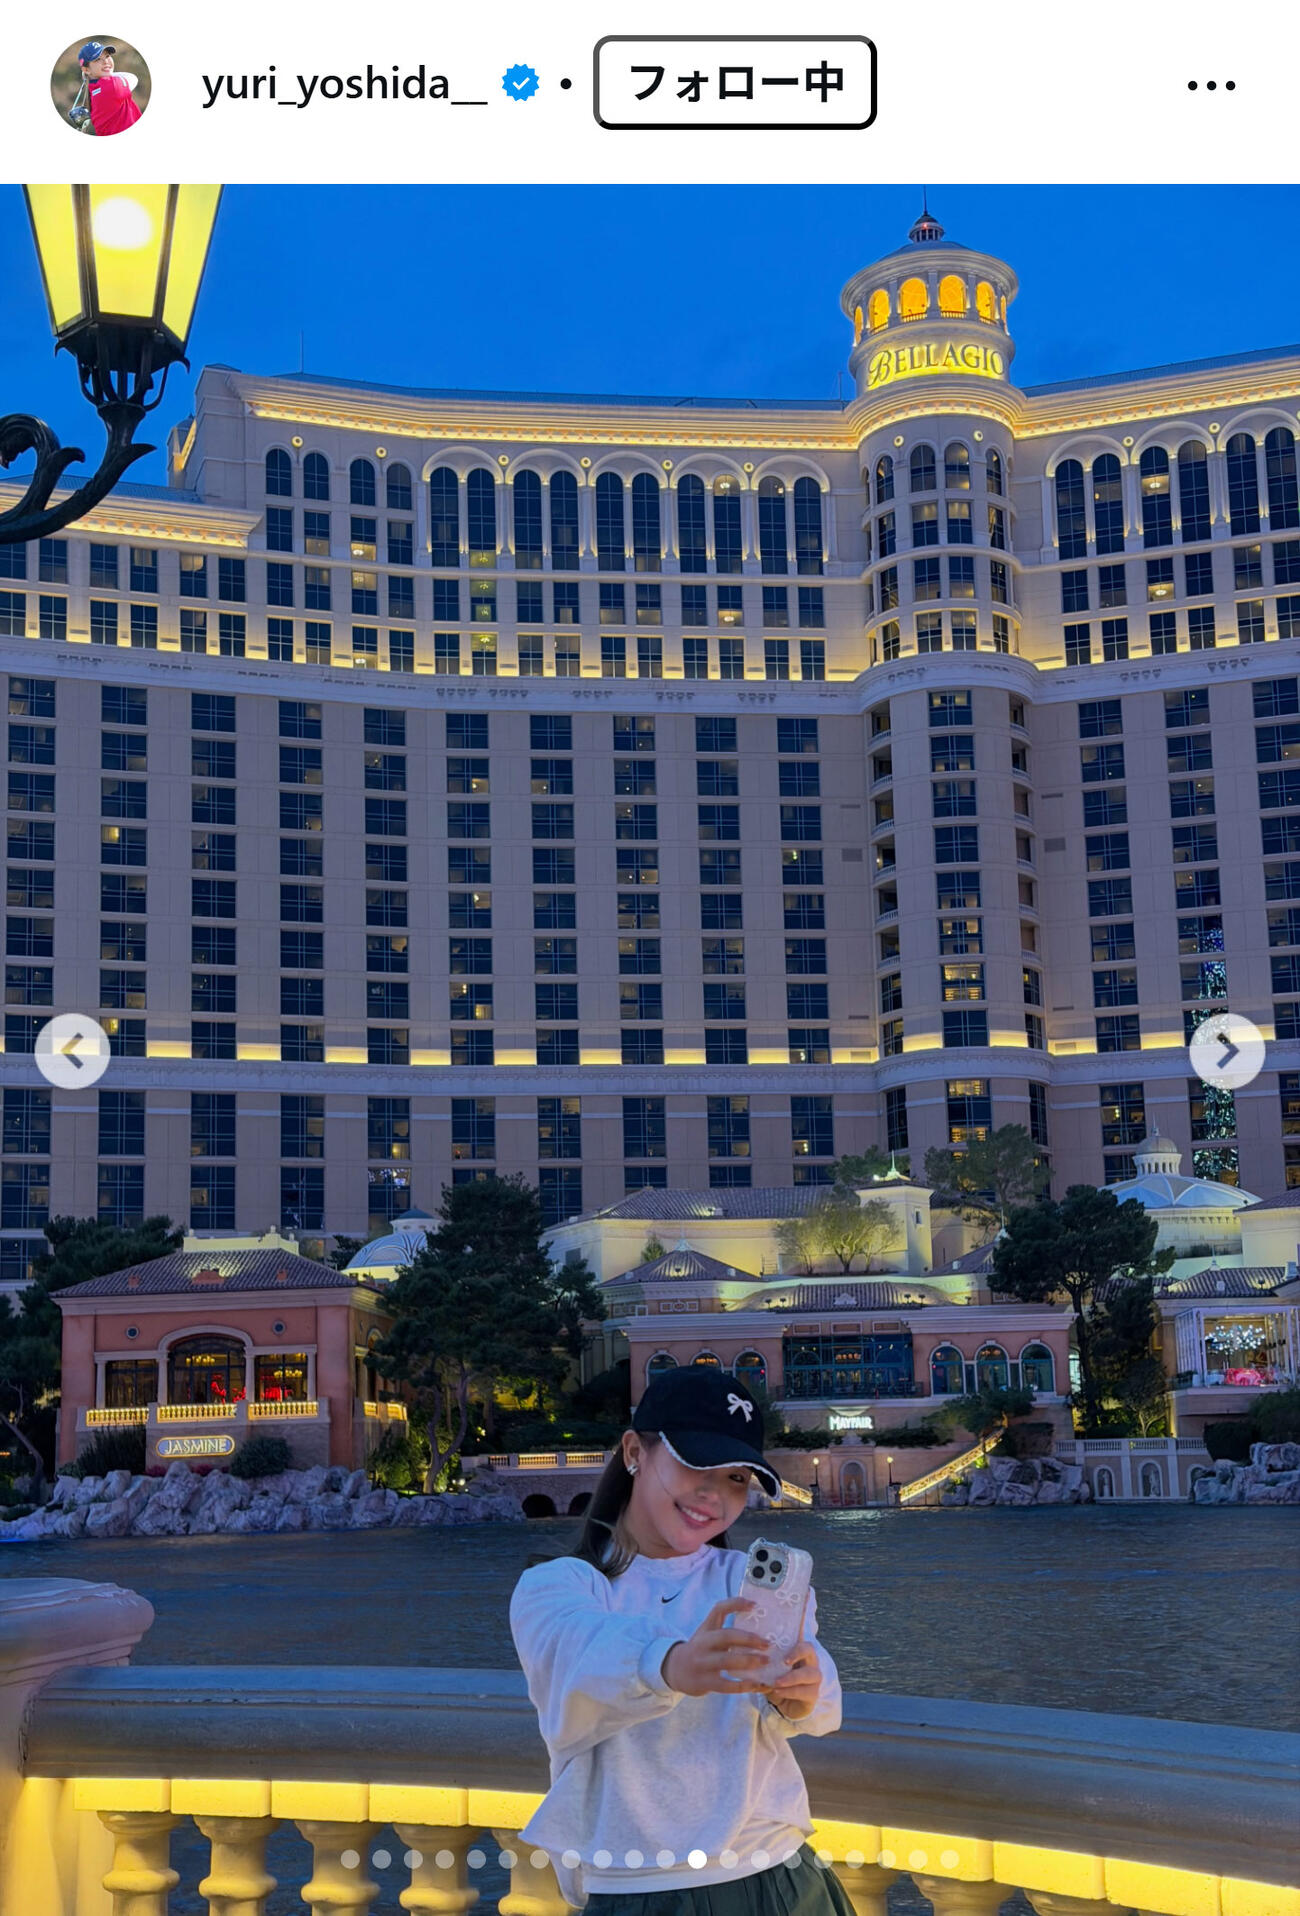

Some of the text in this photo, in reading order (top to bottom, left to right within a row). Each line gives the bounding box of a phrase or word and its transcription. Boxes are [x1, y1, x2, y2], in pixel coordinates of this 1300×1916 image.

[866, 343, 1005, 387] BELLAGIO
[829, 1415, 874, 1431] MAYFAIR
[164, 1438, 227, 1455] JASMINE
